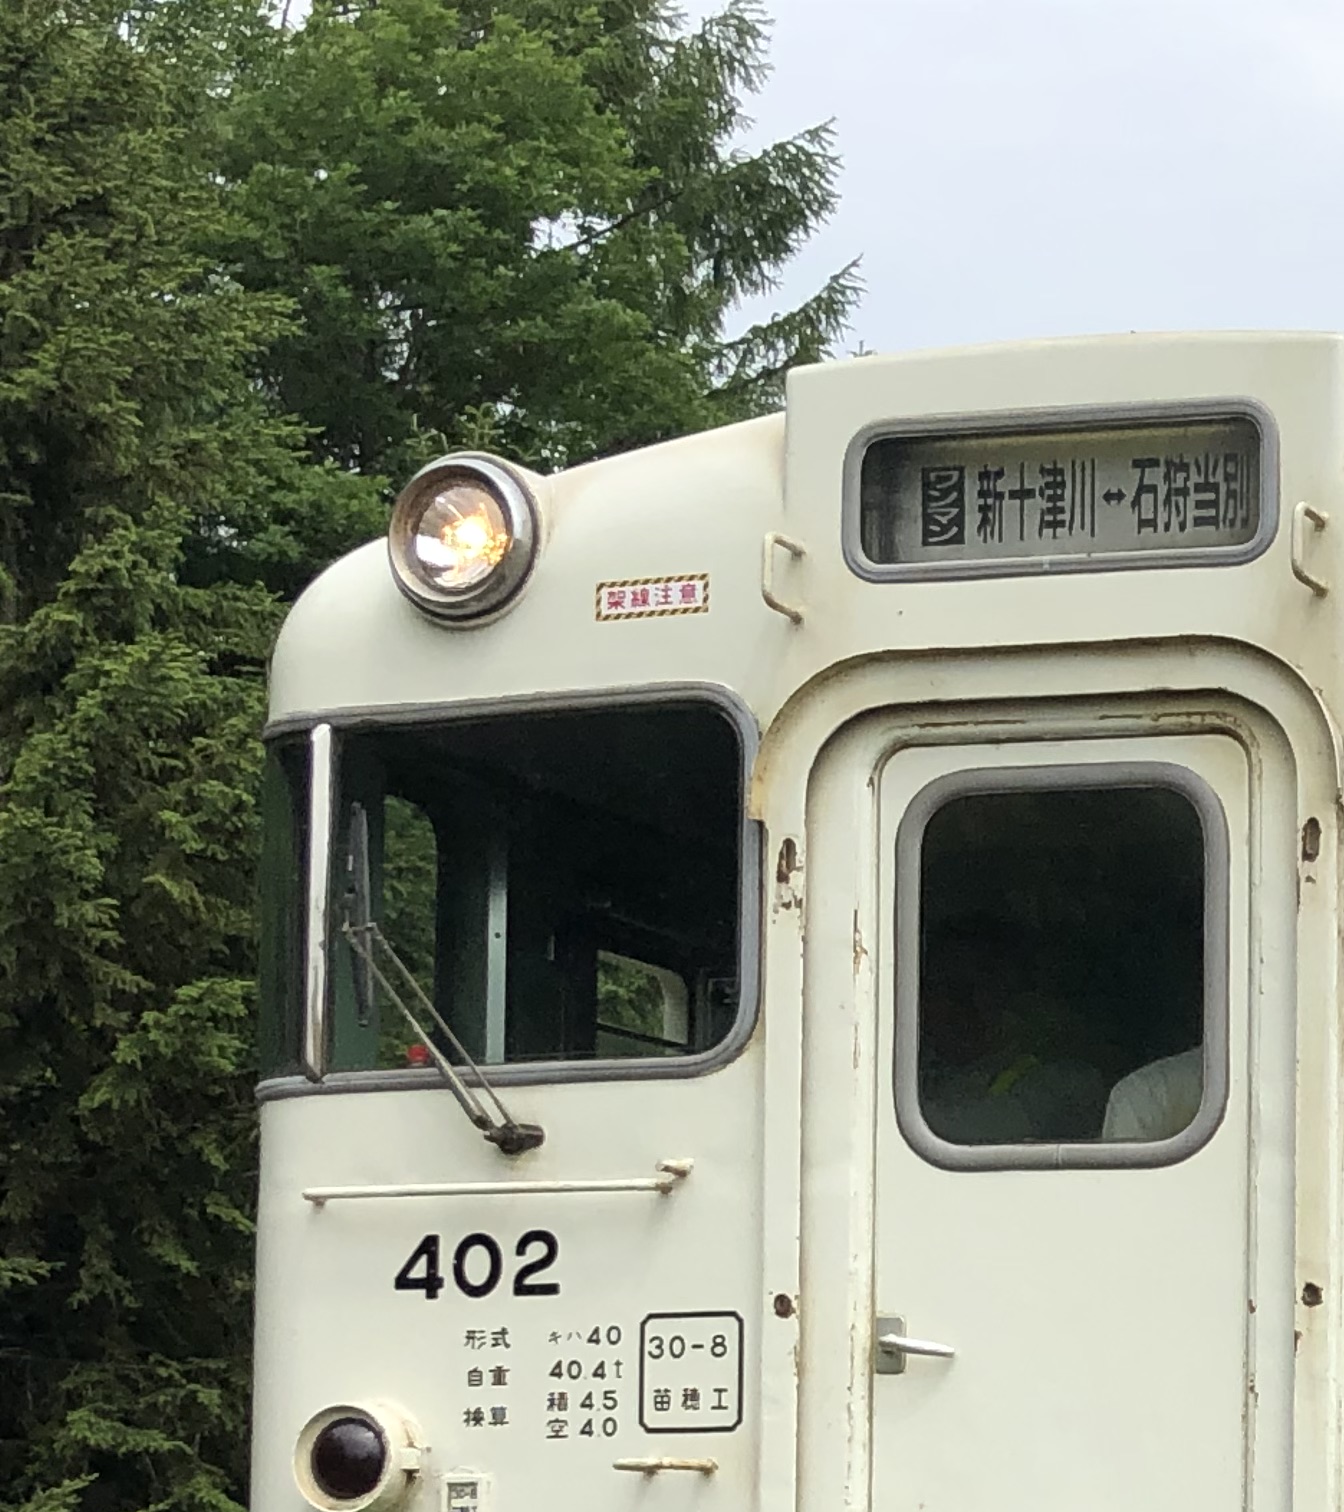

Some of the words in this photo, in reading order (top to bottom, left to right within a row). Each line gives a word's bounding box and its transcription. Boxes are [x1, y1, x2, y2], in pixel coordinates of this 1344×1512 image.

[928, 470, 961, 543] ワンマン
[976, 457, 1097, 544] 新十津川
[1130, 451, 1251, 535] 石狩当別
[606, 583, 698, 610] 架線注意
[394, 1229, 561, 1300] 402
[464, 1327, 511, 1350] 形式
[647, 1333, 729, 1359] 30-8
[467, 1365, 511, 1387] 自重
[653, 1387, 729, 1412] 苗穂工
[463, 1406, 510, 1427] 換算
[546, 1417, 569, 1439] 空
